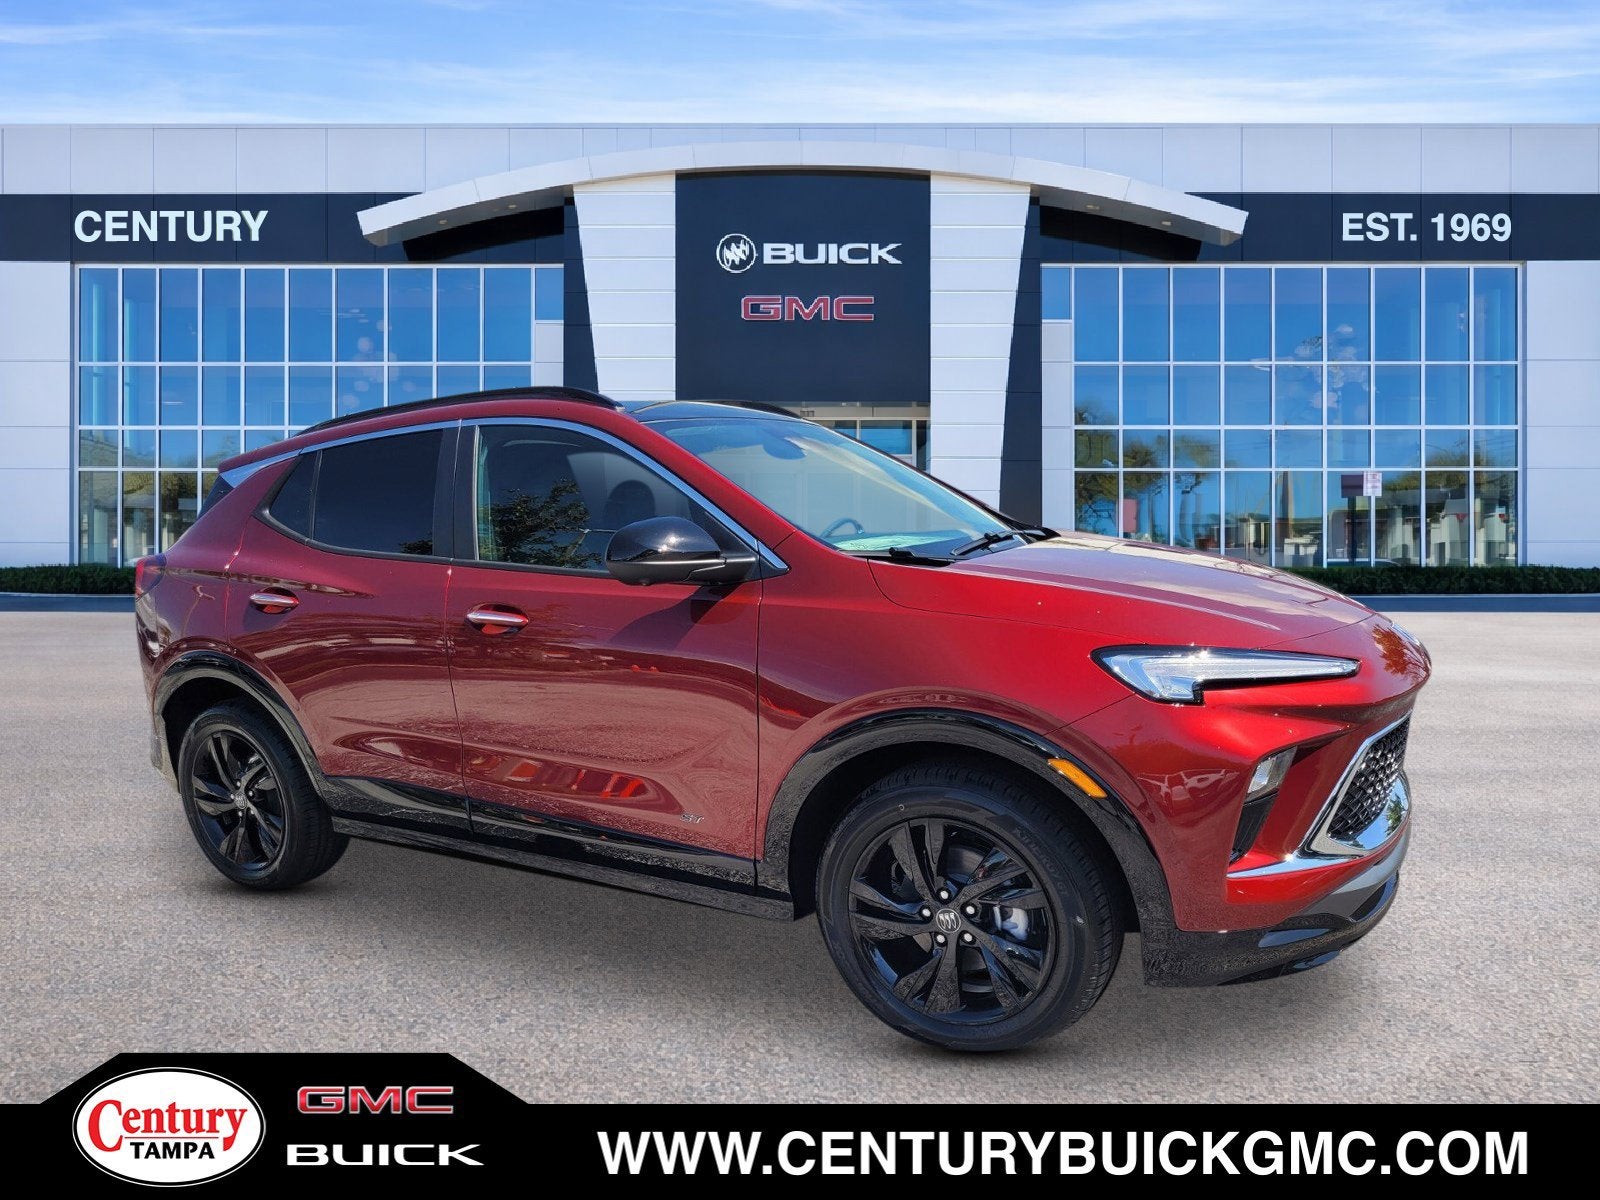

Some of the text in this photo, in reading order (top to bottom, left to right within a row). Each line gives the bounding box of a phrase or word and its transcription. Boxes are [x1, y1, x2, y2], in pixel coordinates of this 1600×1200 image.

[74, 210, 269, 243] CENTURY
[1342, 212, 1512, 242] EST. 1969
[763, 243, 903, 265] BUICK
[740, 295, 875, 321] GMC
